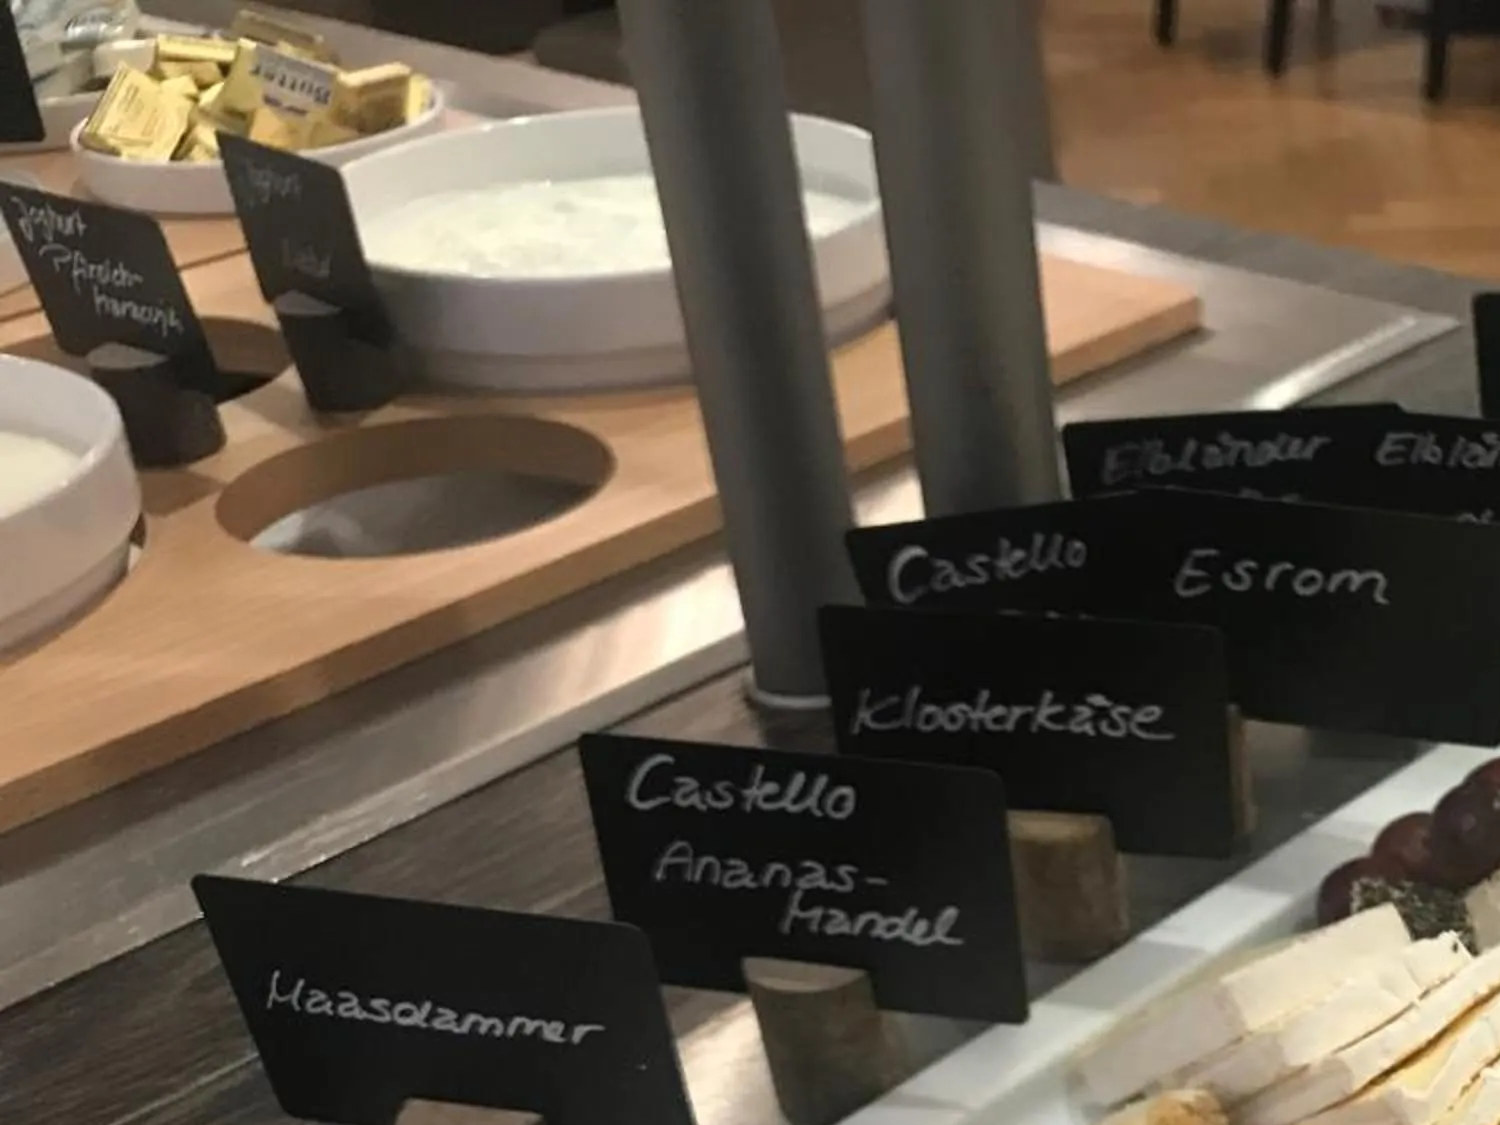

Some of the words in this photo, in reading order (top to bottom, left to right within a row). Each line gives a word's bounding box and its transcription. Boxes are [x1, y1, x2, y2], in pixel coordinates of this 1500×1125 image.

[886, 531, 1088, 604] Castello
[1173, 548, 1391, 604] Esrom
[850, 688, 1177, 741] Klosterkäse
[627, 753, 857, 820] Castello
[654, 840, 889, 892] Ananas-
[779, 891, 965, 945] Mandel
[266, 970, 606, 1045] Maasdammer
